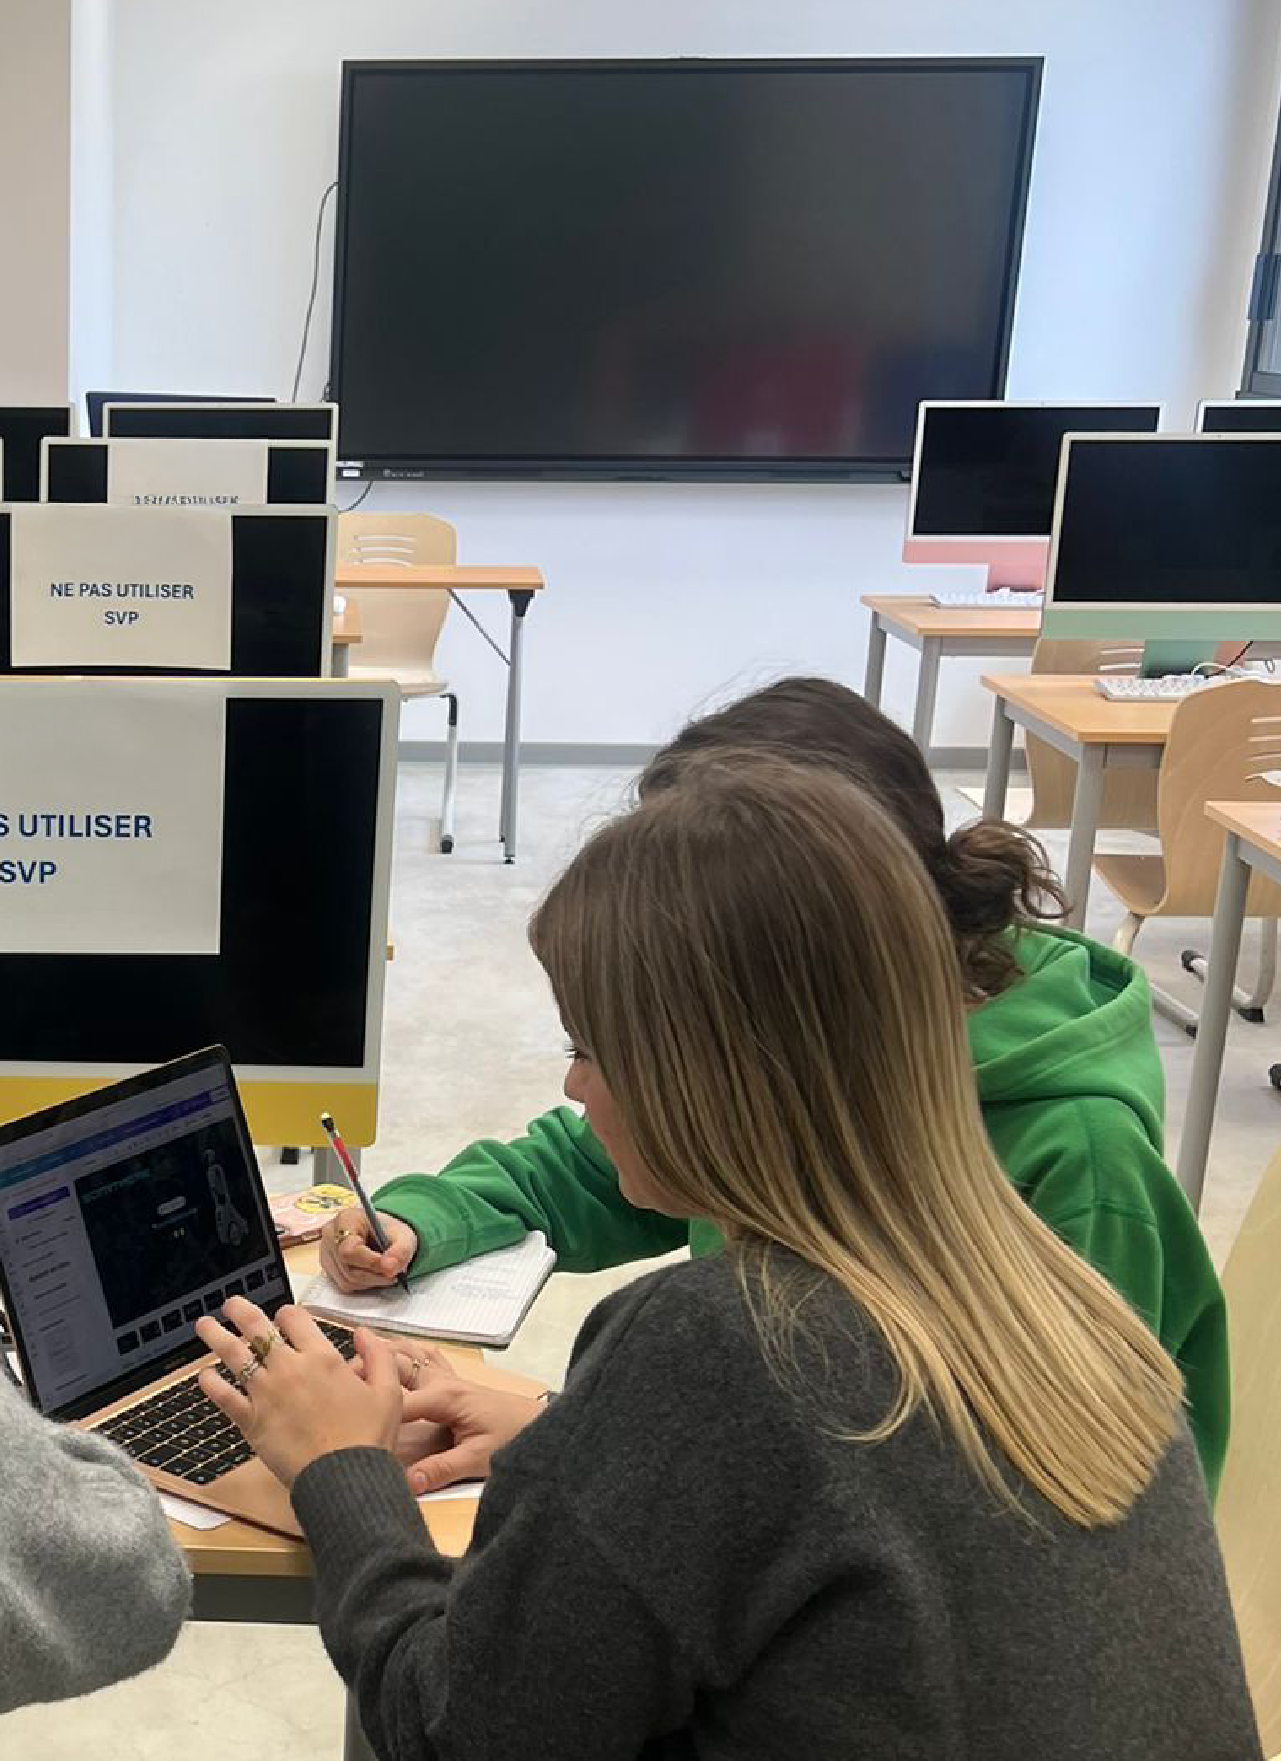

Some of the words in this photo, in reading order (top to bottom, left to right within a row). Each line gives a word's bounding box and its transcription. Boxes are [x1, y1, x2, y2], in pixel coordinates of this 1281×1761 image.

[50, 582, 74, 598] NE
[79, 583, 113, 598] PAS
[116, 583, 194, 600] UTILISER
[104, 610, 140, 625] SVP
[18, 814, 153, 839] UTILISER
